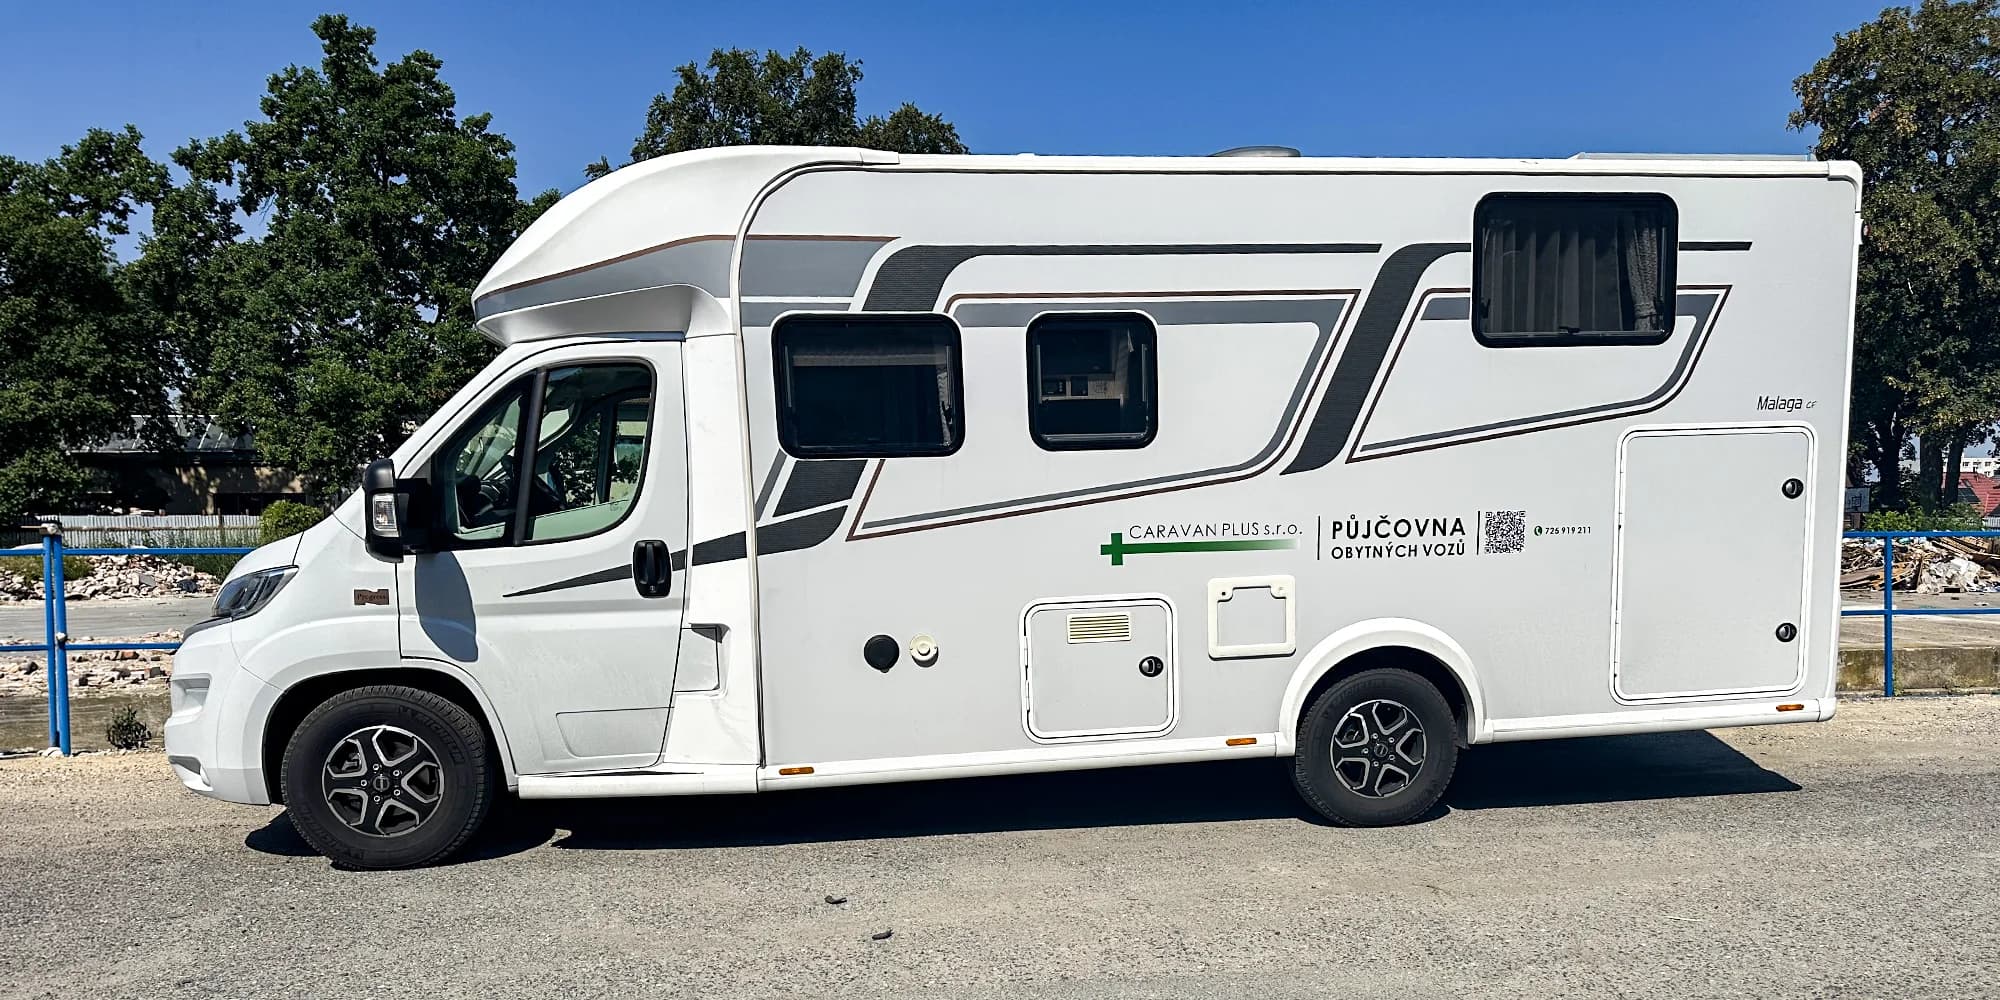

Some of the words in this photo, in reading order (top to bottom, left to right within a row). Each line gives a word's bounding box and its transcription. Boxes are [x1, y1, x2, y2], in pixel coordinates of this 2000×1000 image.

[1757, 395, 1803, 412] Malaga
[1129, 523, 1217, 539] CARAVAN
[1222, 522, 1259, 537] PLUS
[1263, 523, 1303, 536] s.r.o.
[1331, 513, 1466, 540] PŮJČOVNA
[1561, 526, 1576, 535] 919
[1577, 526, 1591, 535] 211
[1331, 541, 1418, 560] OBYTNÝCH
[1422, 538, 1465, 557] VOZŮ
